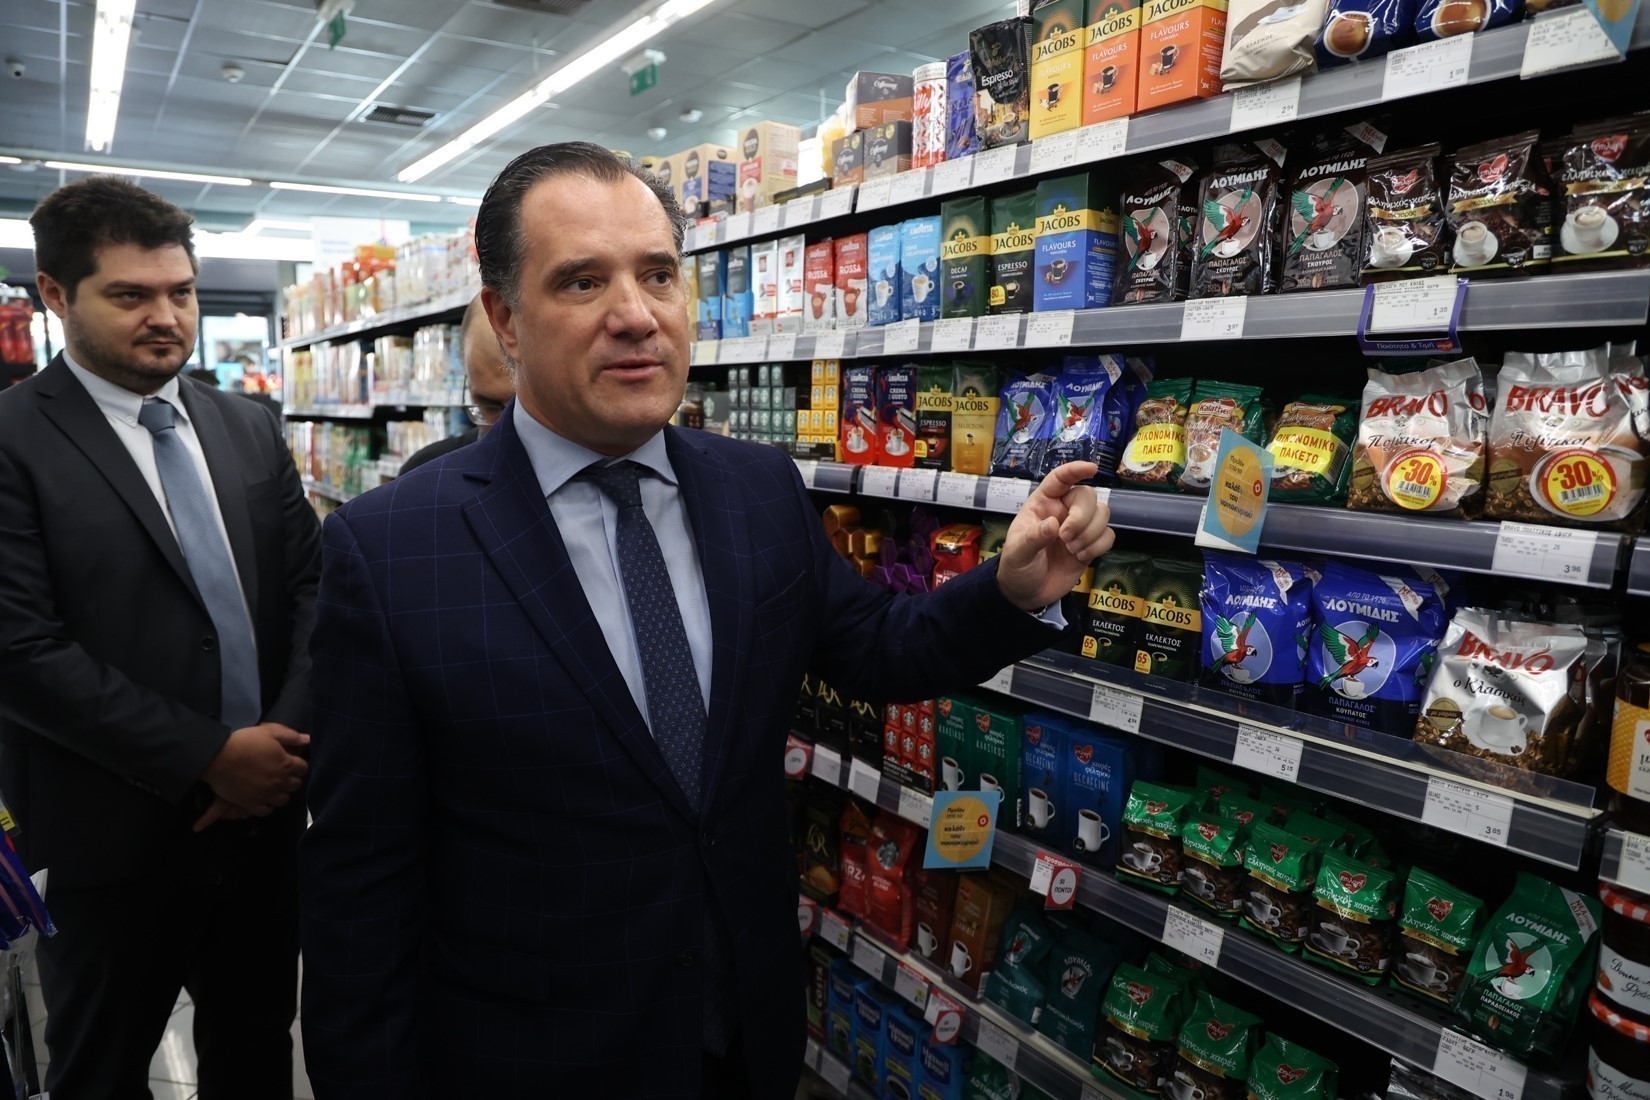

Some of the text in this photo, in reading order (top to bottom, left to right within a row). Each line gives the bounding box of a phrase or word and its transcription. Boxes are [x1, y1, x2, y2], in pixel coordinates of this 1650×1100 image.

[1089, 14, 1133, 43] JACOBS
[1150, 20, 1190, 41] FLAVOURS
[1035, 33, 1077, 60] JACOBS
[1091, 42, 1129, 62] FLAVOURS
[980, 68, 1015, 87] Espresso
[1298, 158, 1367, 180] ΛΟΥΜΙΔΗΣ
[1209, 168, 1270, 190] ΛΟΥΜΙΔΗΣ
[1126, 185, 1176, 205] ΛΟΥΜΙΔΗΣ
[1038, 215, 1080, 234] JACOBS
[942, 240, 978, 257] JACOBS
[992, 232, 1034, 252] JACOBS
[1042, 240, 1077, 252] FLAVOURS
[1207, 256, 1248, 269] ΠΑΠΑΓΑΛΟΣ
[1299, 250, 1343, 262] ΠΑΠΑΓΑΛΟΣ
[1307, 259, 1333, 268] ΣΚΟΥΡΟΣ
[807, 269, 829, 281] ROSSA
[838, 263, 862, 276] ROSSA
[950, 265, 968, 275] DECAF
[997, 260, 1028, 272] ESPRESSO
[889, 387, 907, 395] CREMA
[1505, 379, 1611, 418] BRAVO
[918, 395, 952, 408] JACOBS
[955, 400, 989, 412] JACOBS
[1366, 389, 1448, 419] BRAVO
[918, 419, 947, 428] ESPRESSO
[1136, 430, 1185, 443] ΟΙΚΟΝΟΜΙΚΟ
[1275, 432, 1335, 453] ΟΙΚΟΝΟΜΙΚΟ
[1142, 444, 1174, 455] ΠΑΚΕΤΟ
[1279, 445, 1320, 465] ΠΑΚΕΤΟ
[1400, 460, 1438, 487] -30%
[1552, 459, 1605, 490] -30%
[1228, 492, 1239, 502] του
[1092, 592, 1135, 612] JACOBS
[1325, 598, 1399, 623] ΛΟΥΜΙΔΗΣ
[1144, 604, 1192, 625] JACOBS
[1092, 618, 1126, 633] ΕΚΛΕΚΤΟΣ
[1083, 636, 1095, 650] 65
[1145, 632, 1182, 648] ΕΚΛΕΚΤΟΣ
[1136, 651, 1148, 665] 65
[1456, 630, 1555, 675] BRAVO
[1328, 696, 1375, 713] ΠΑΠΑΓΑΛΟΣ
[1335, 707, 1367, 719] ΚΟΥΠΑΤΟΣ
[976, 740, 1005, 759] ΚΛΑΣΙΚΟΣ
[1505, 911, 1571, 945] ΛΟΥΜΙΔΗΣ
[1479, 995, 1521, 1019] ΠΑΡΑΔΟΣΙΑΚΟΣ
[1482, 987, 1525, 1014] ΠΑΠΑΓΑΛΟΣ
